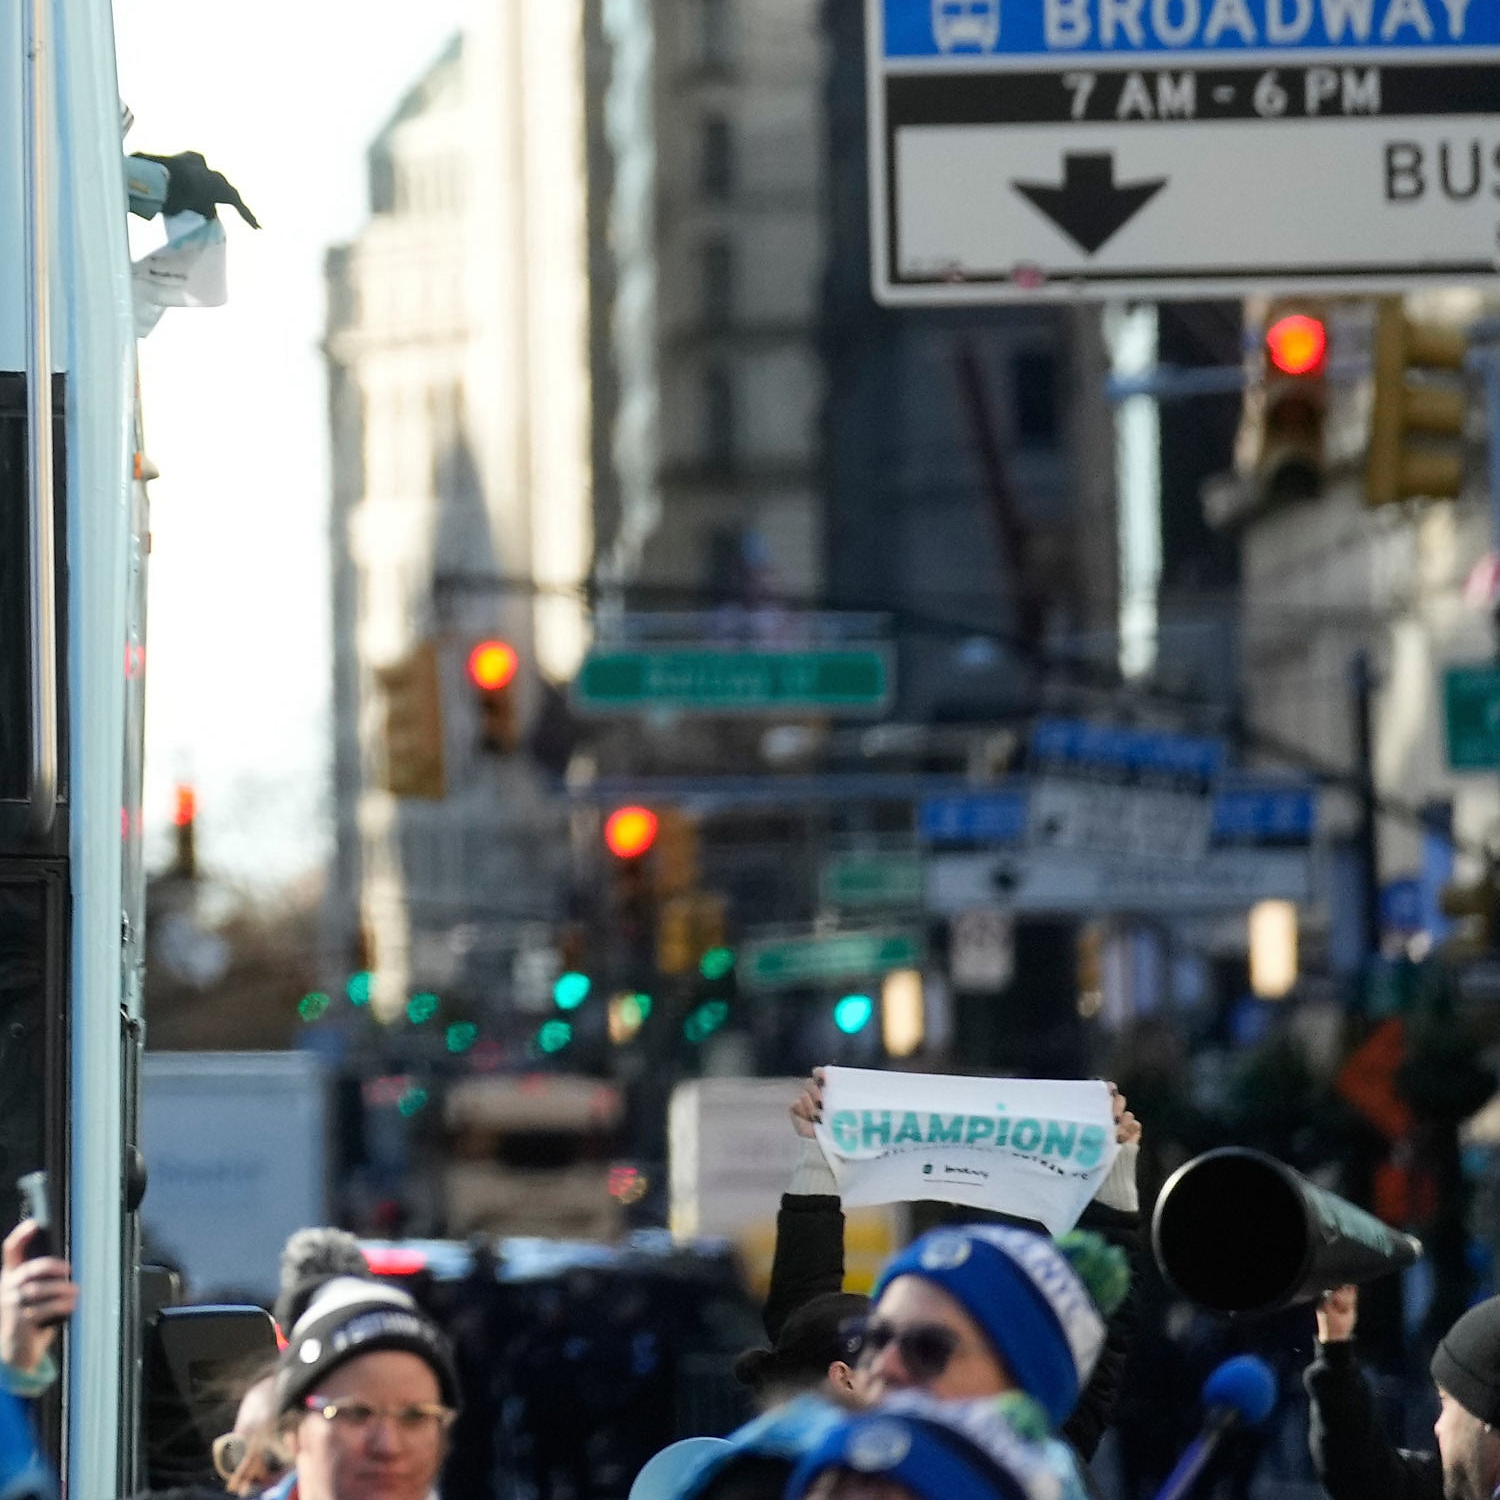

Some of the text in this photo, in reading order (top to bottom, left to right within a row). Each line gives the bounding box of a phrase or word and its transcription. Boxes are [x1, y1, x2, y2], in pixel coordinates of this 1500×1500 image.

[1062, 72, 1097, 121] 7
[1115, 71, 1197, 120] AM
[1253, 69, 1288, 118] 6
[1304, 66, 1382, 115] PM
[1385, 137, 1500, 203] BU
[830, 1109, 1107, 1169] CHAMPIONS
